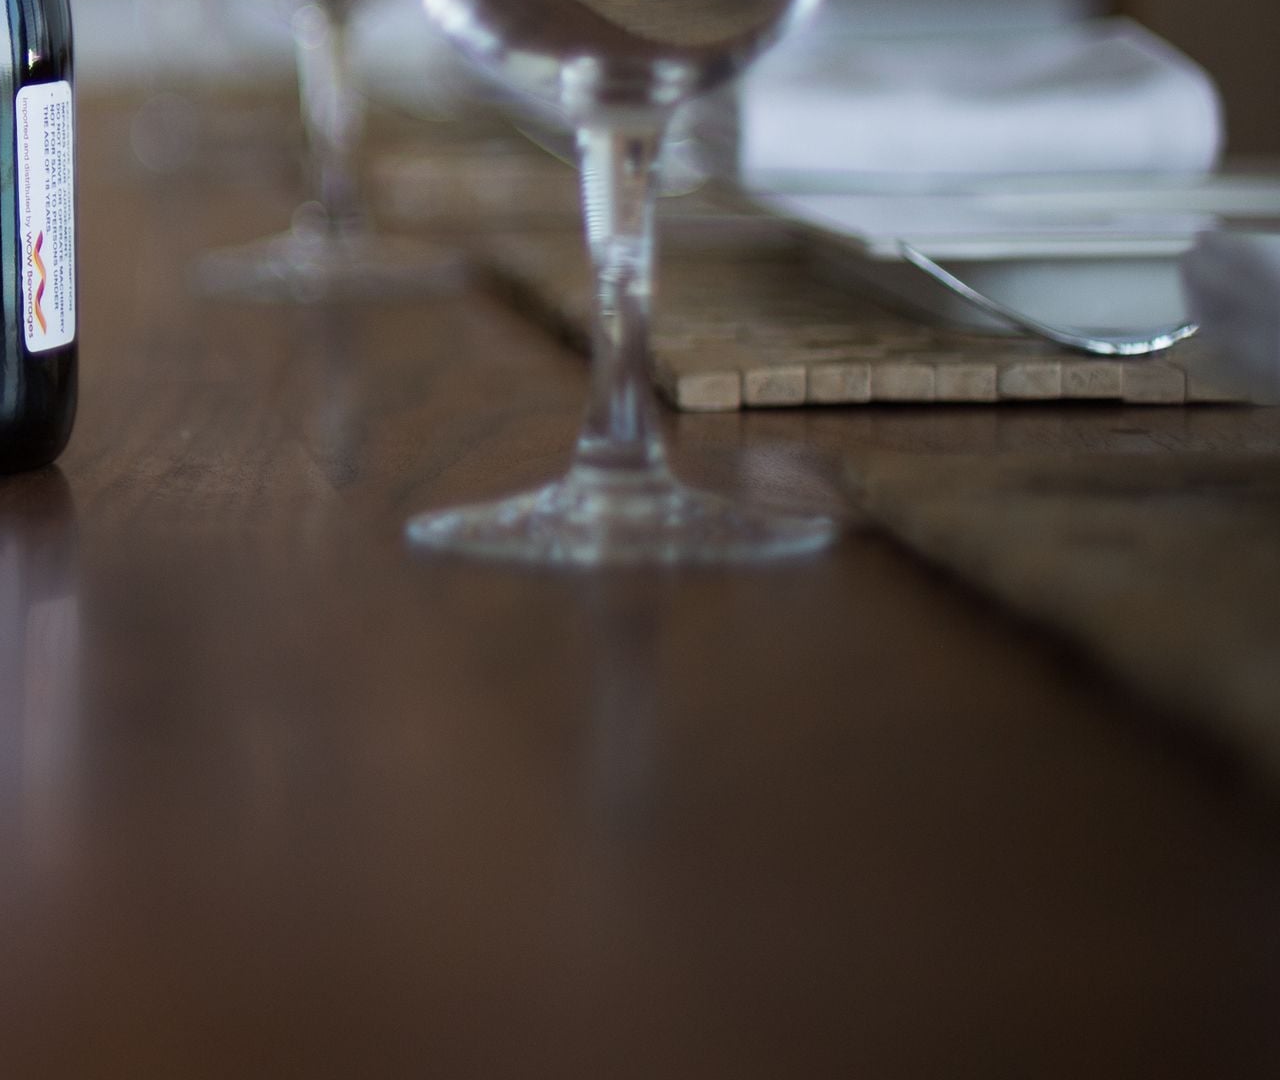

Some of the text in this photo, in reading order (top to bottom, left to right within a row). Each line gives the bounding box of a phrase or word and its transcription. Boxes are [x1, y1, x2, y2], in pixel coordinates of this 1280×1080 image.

[24, 163, 32, 213] distributed
[24, 216, 32, 228] by
[26, 270, 34, 339] Beverages
